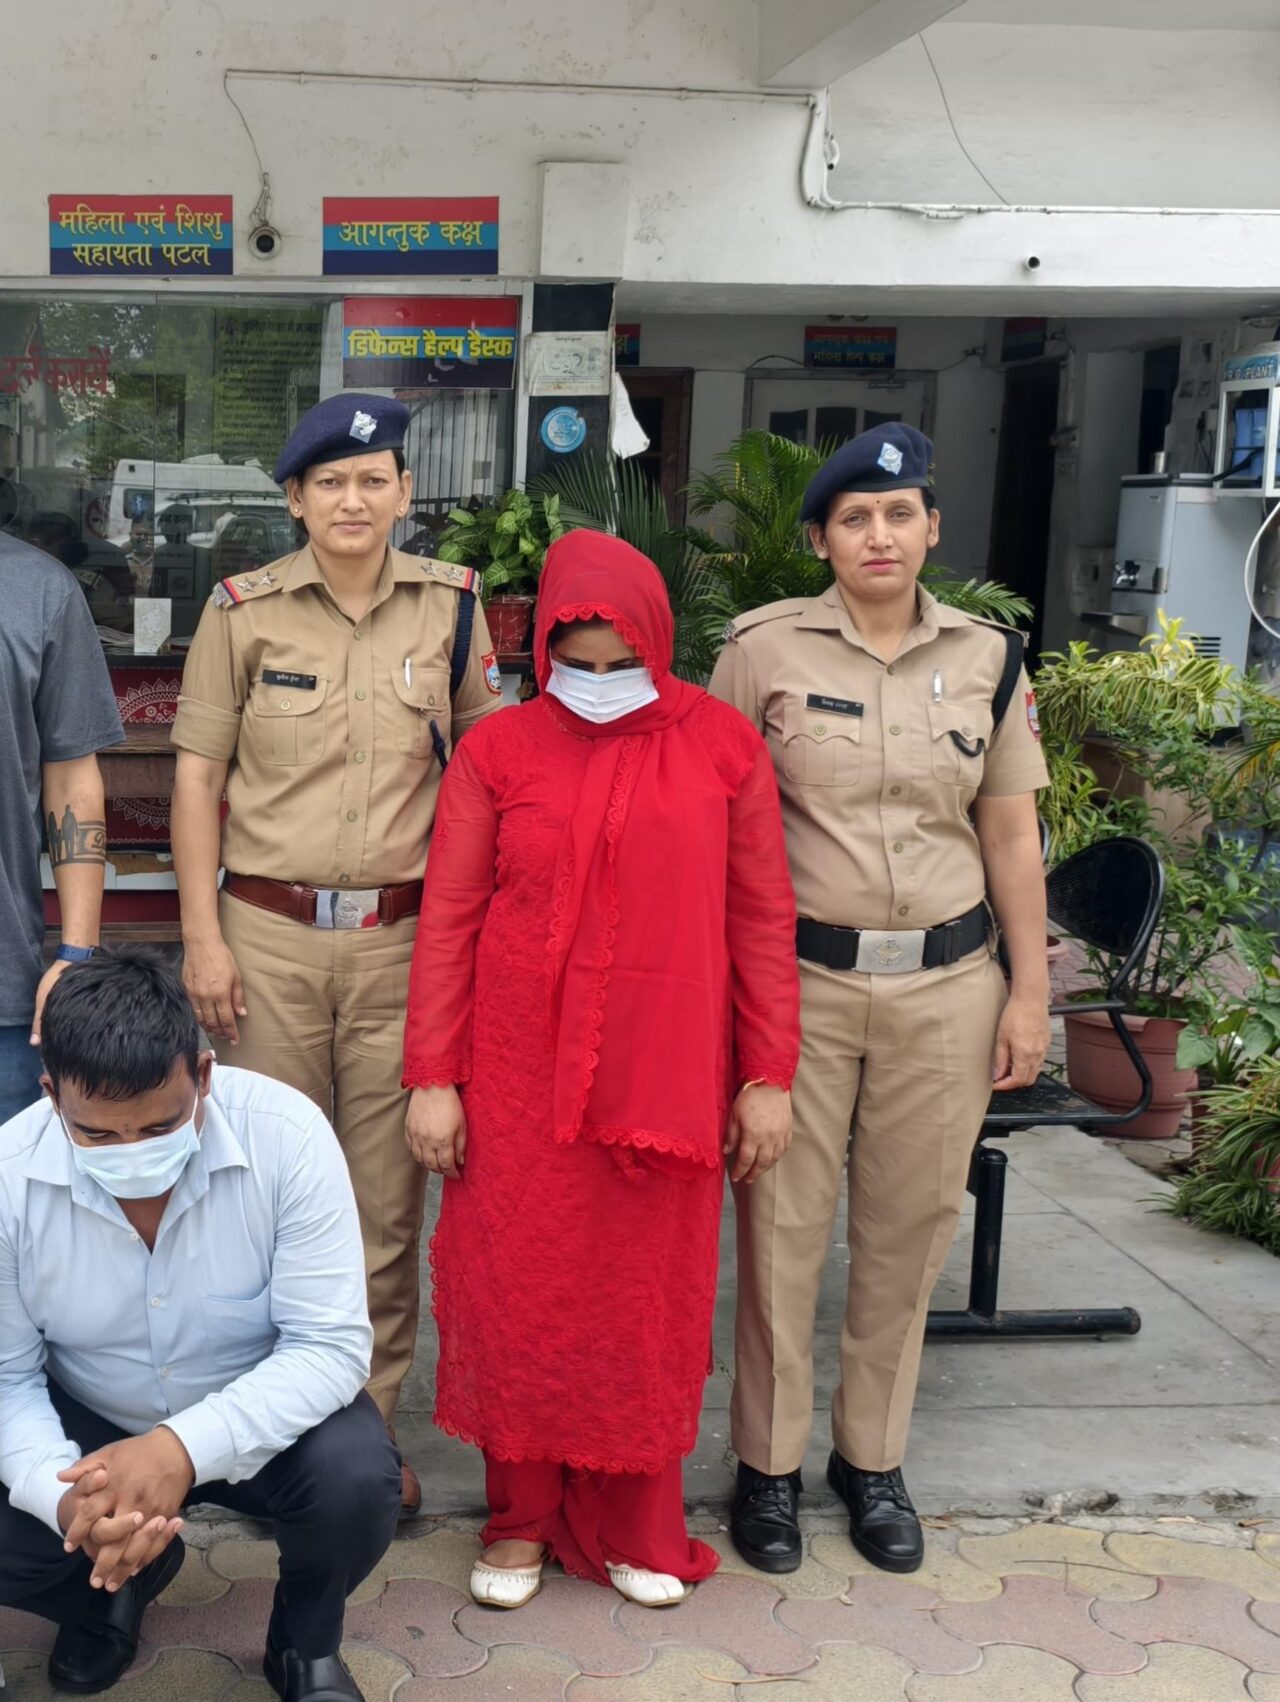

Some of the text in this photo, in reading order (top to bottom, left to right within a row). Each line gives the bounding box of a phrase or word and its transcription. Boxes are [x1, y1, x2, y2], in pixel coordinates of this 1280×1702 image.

[59, 203, 223, 241] महिला एवं शिशु
[339, 221, 483, 252] आगन्तुक कक्ष
[72, 243, 211, 267] सहायता पटल
